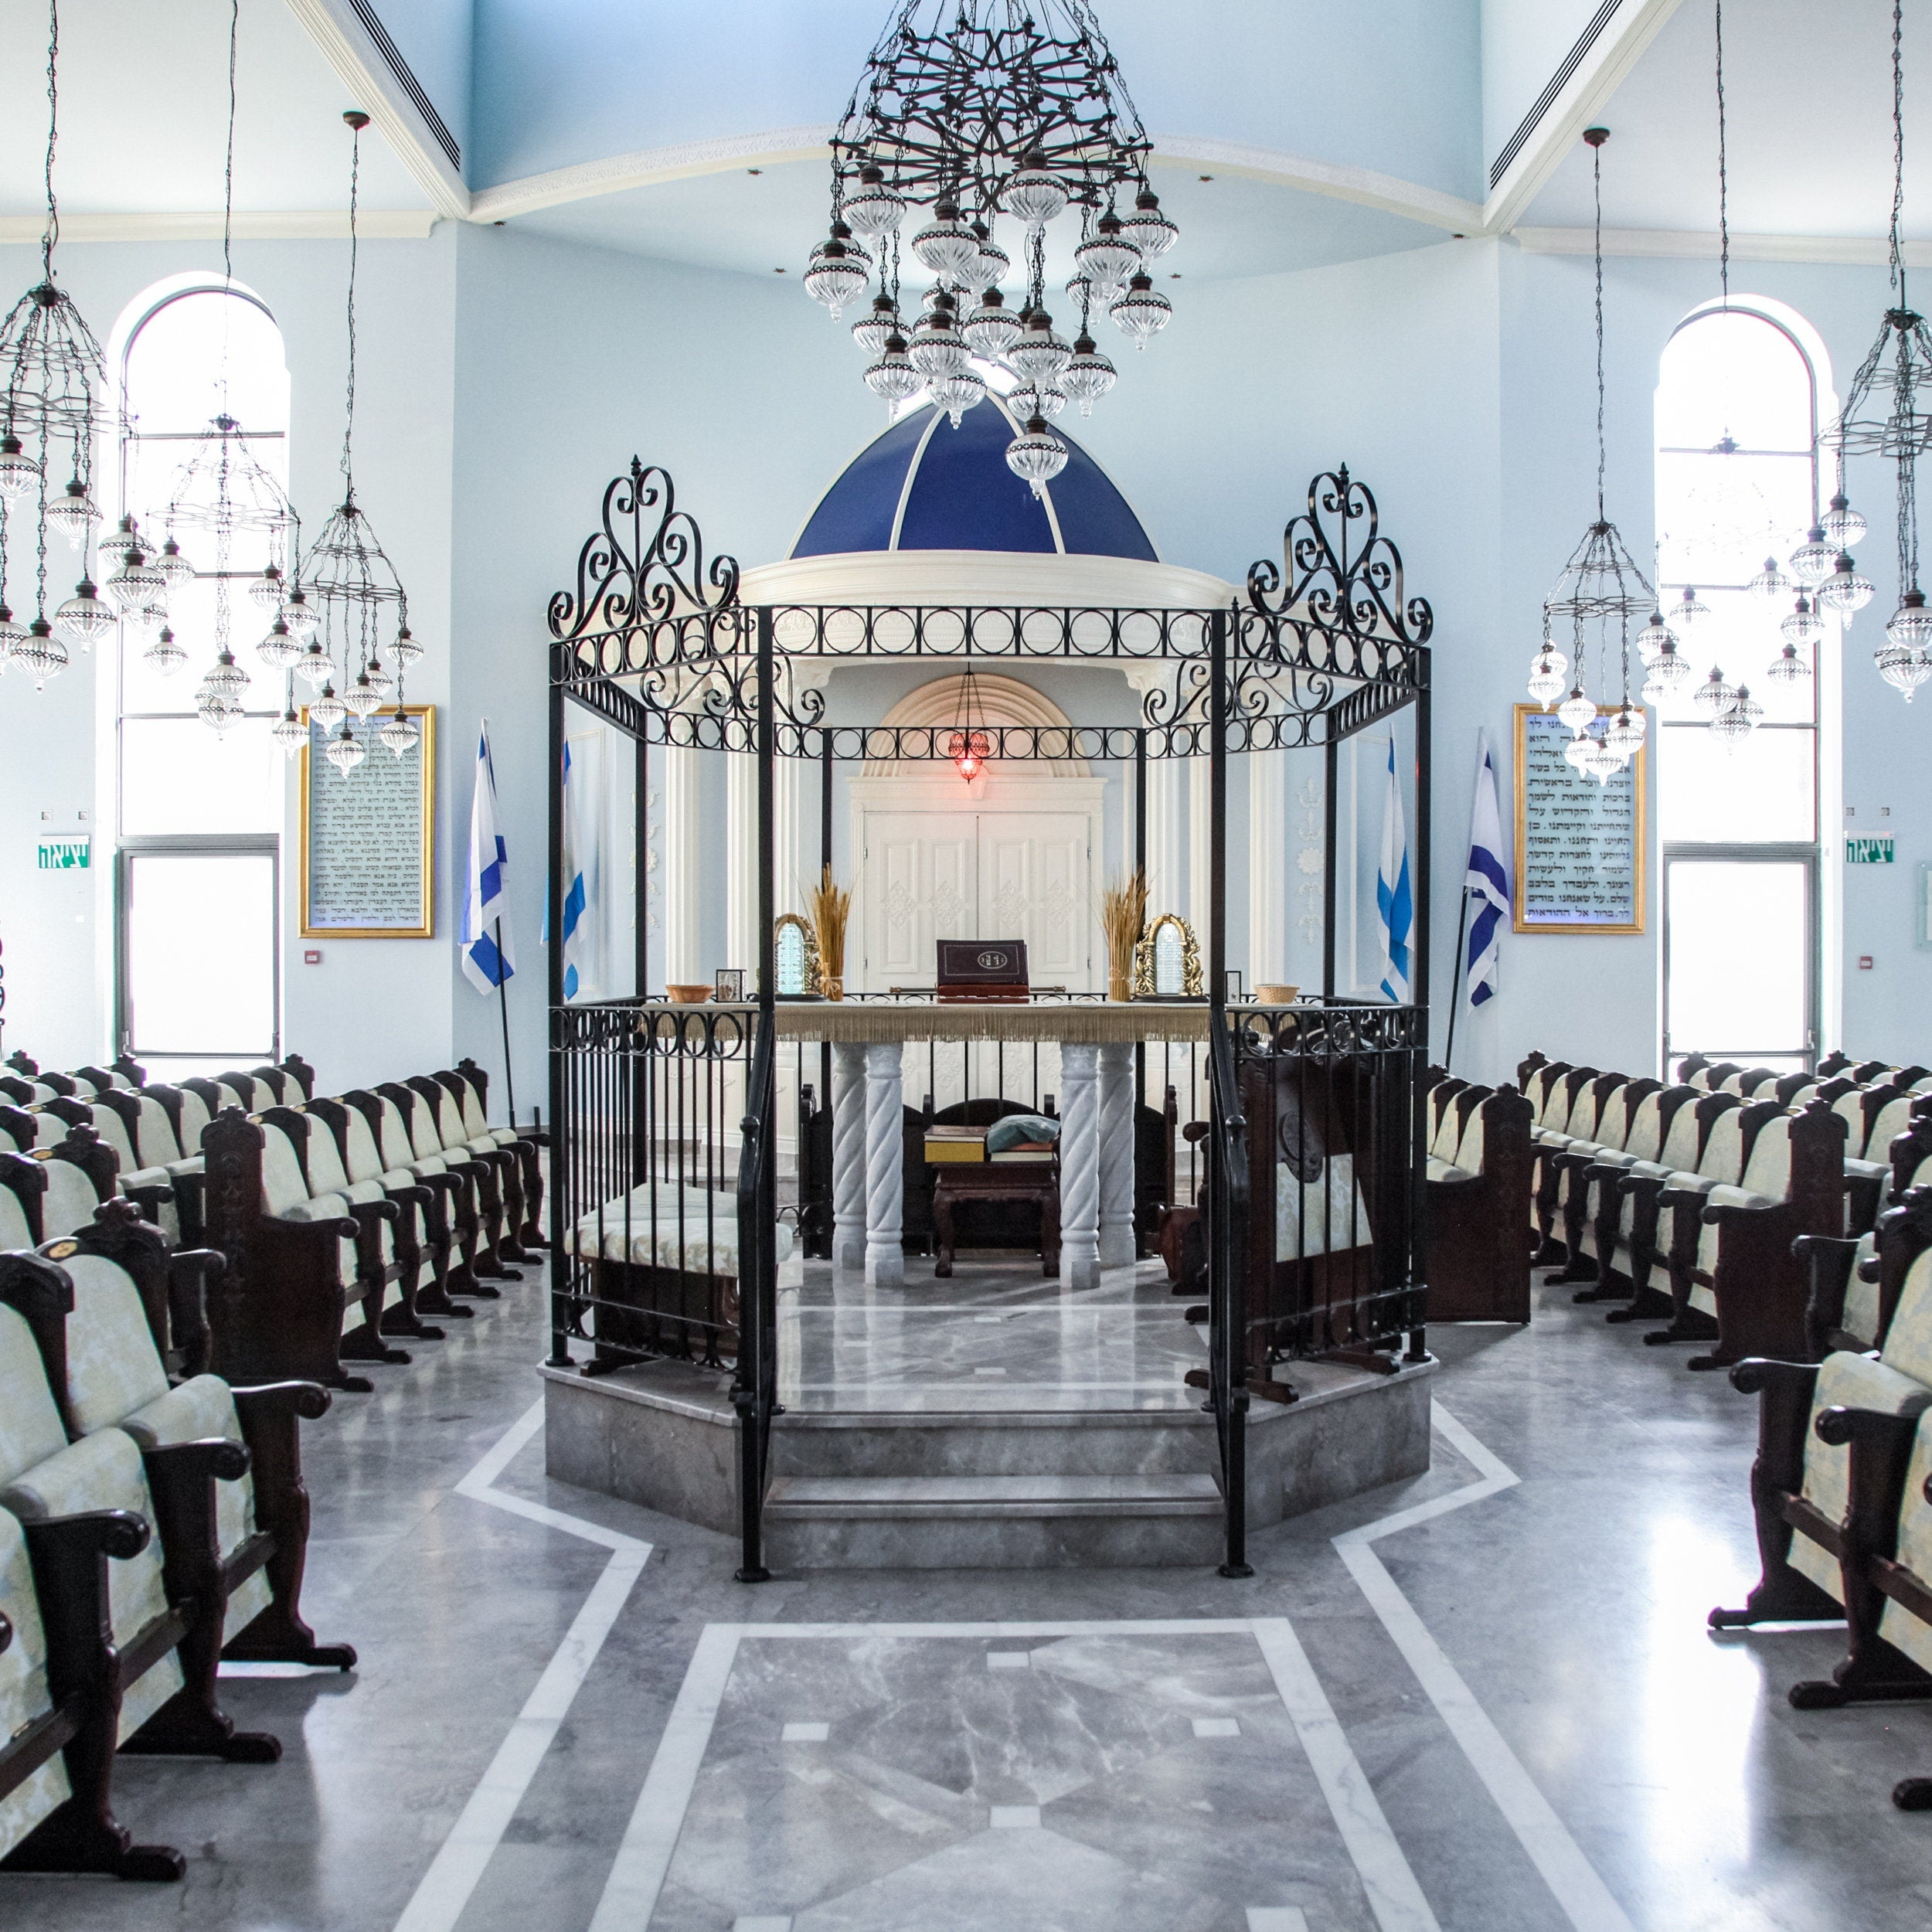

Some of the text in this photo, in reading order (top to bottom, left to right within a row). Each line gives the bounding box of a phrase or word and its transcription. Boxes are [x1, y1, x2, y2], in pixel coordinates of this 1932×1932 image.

[1529, 717, 1542, 730] לך
[1554, 761, 1566, 772] כל
[1529, 789, 1555, 803] לשמך
[1529, 804, 1631, 818] הגדול והקדוש על
[1529, 822, 1540, 832] כן
[1529, 836, 1560, 846] ותאסוף
[40, 845, 87, 869] יציאה
[1848, 839, 1892, 863] יציאה
[1528, 861, 1566, 872] ולעשות
[1602, 861, 1630, 872] לשמור
[1594, 890, 1605, 902] על
[1575, 905, 1589, 917] אל
[1594, 909, 1614, 919] ברוך
